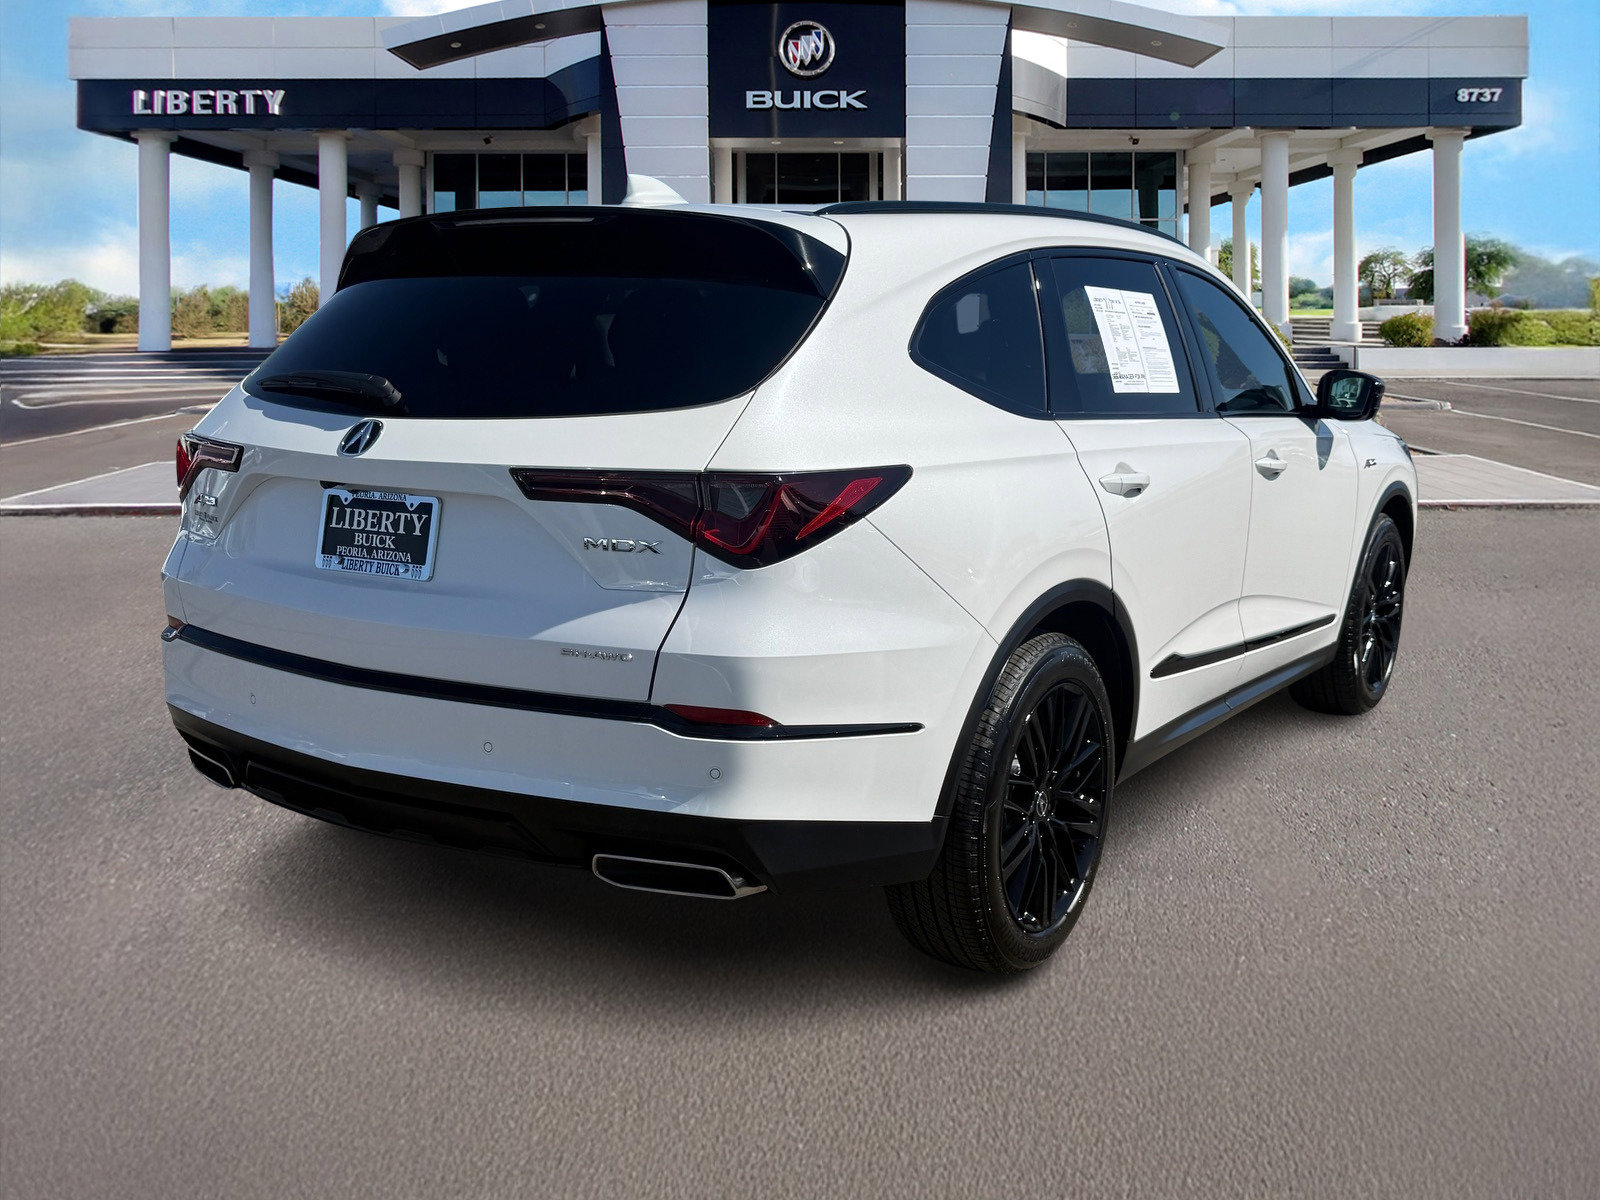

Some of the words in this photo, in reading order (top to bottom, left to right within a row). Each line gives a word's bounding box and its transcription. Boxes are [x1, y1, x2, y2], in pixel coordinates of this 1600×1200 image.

[132, 89, 286, 116] LIBERTY
[745, 90, 868, 109] BUICK
[1456, 87, 1503, 103] 8737
[379, 492, 407, 502] ARIZONA
[329, 506, 429, 536] LIBERTY
[353, 532, 396, 549] BUICK
[583, 536, 664, 555] MDX
[336, 545, 370, 560] PEORIA,
[370, 549, 412, 563] ARIZONA
[341, 557, 376, 574] LIBERTY
[375, 562, 401, 577] BUICK
